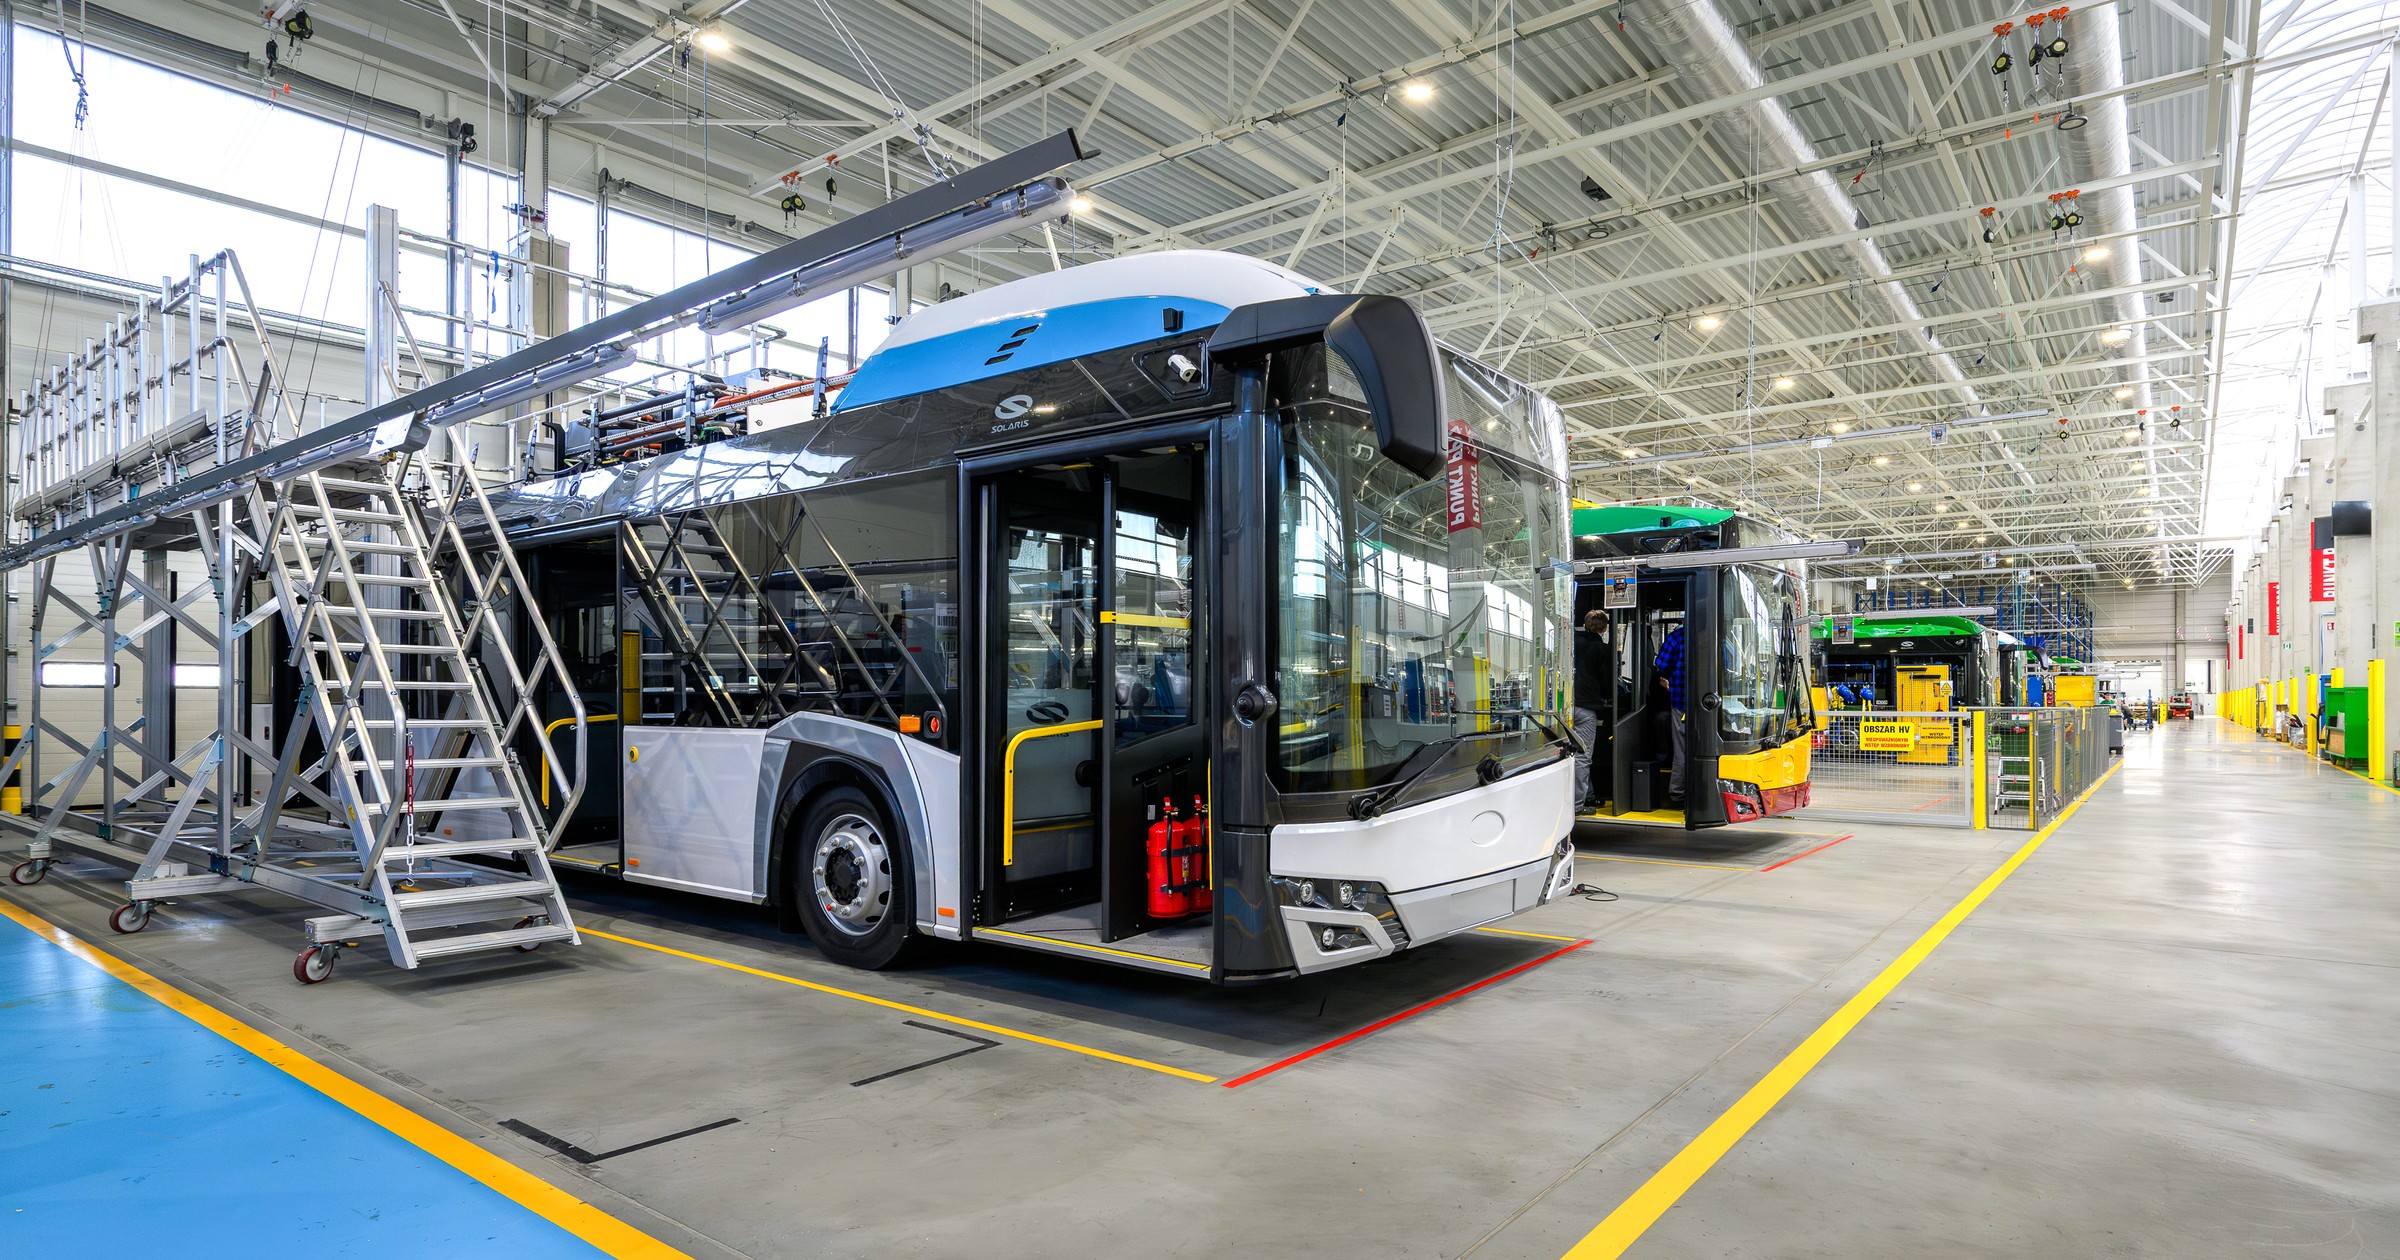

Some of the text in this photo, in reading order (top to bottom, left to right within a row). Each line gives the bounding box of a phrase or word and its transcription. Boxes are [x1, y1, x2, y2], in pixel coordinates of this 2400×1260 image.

[991, 420, 1029, 434] SOLARIS
[1864, 725, 1910, 733] OBSZAR HV
